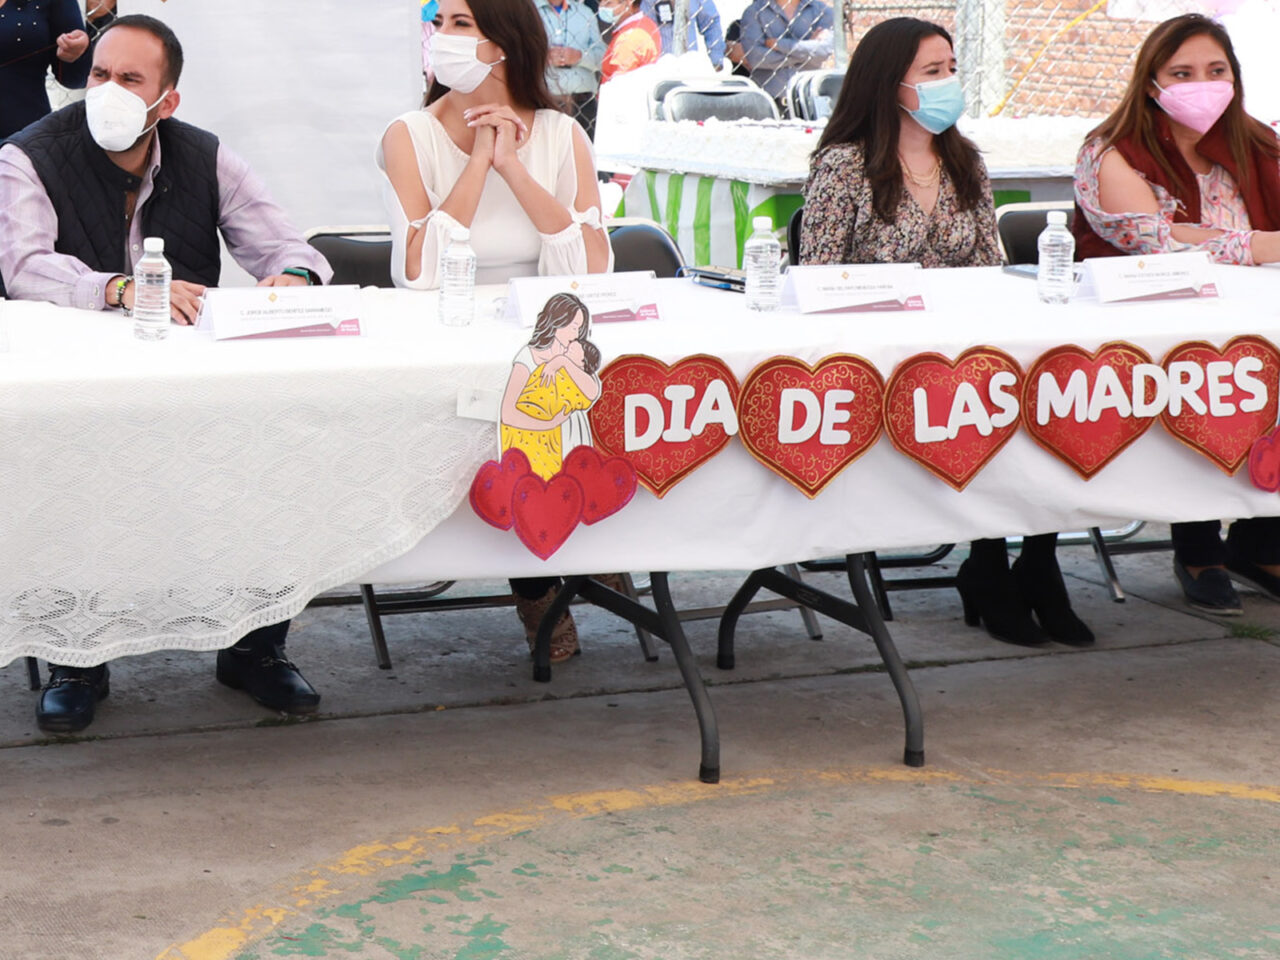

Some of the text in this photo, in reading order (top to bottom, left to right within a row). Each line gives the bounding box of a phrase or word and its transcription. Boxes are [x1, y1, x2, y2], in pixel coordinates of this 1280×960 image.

[624, 356, 1269, 453] DIA DE LAS MADRES
